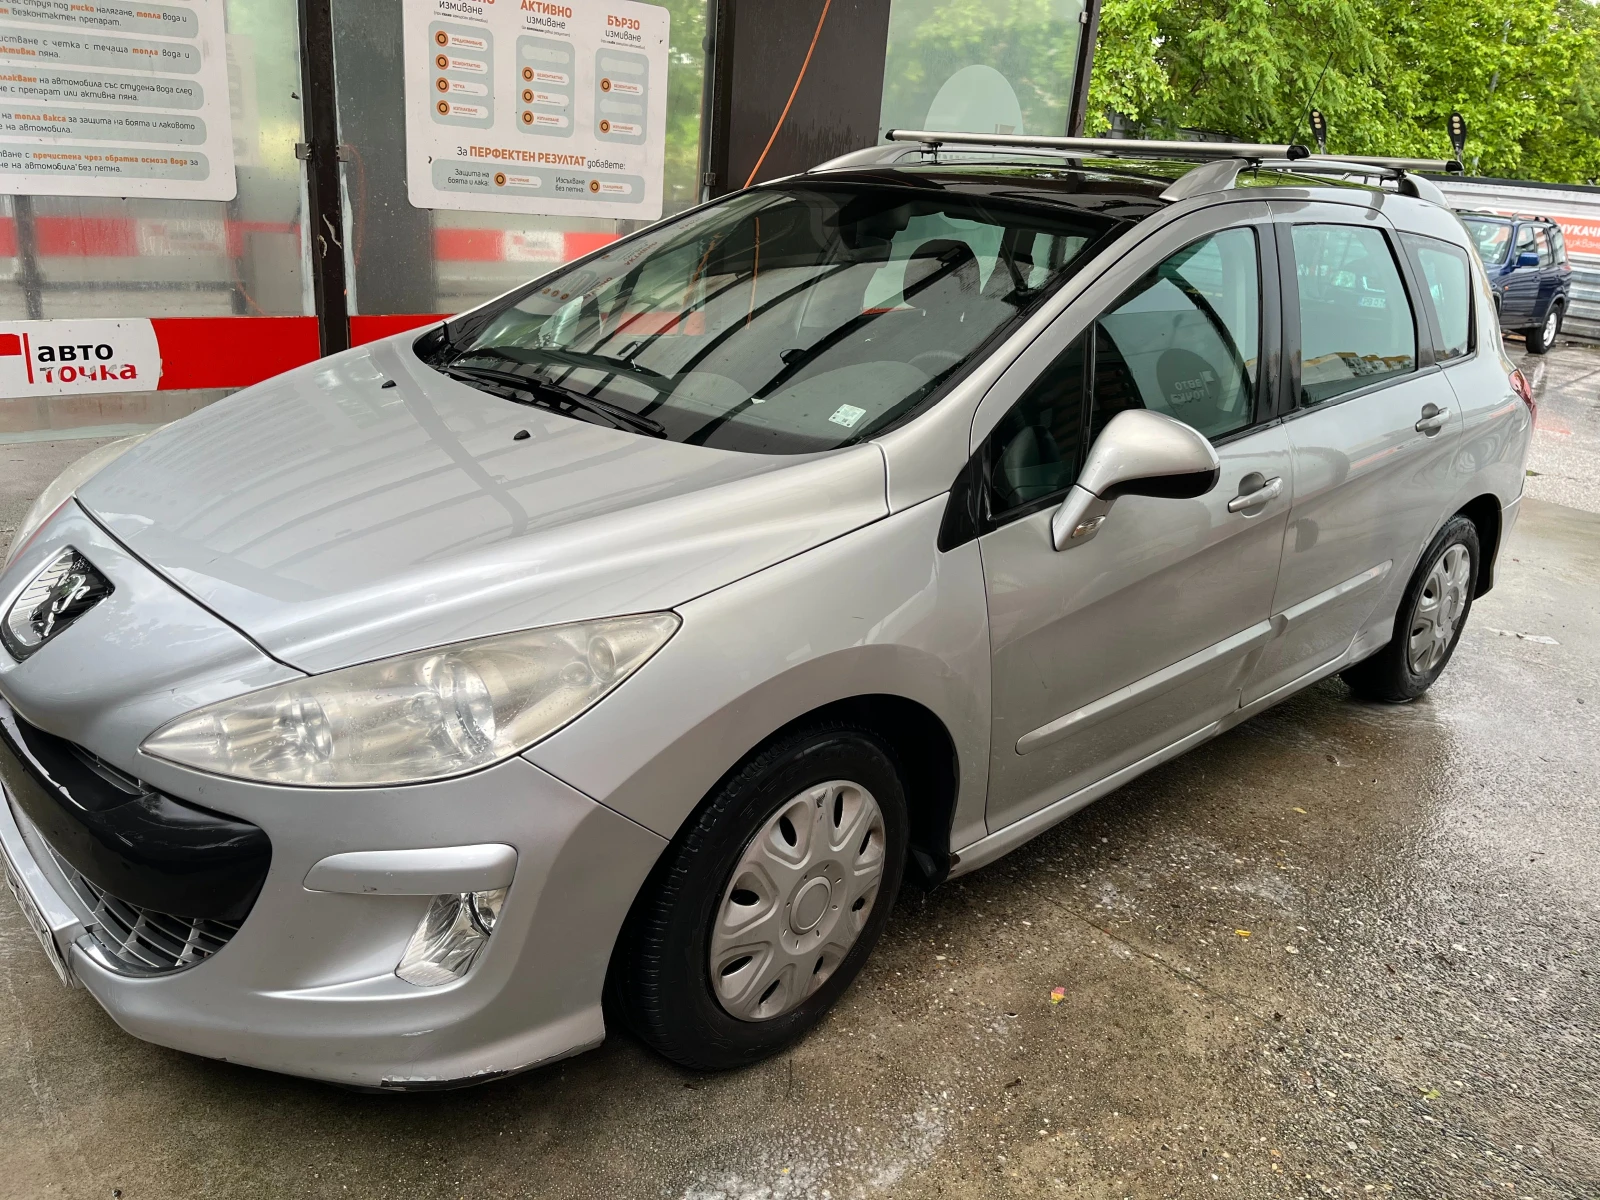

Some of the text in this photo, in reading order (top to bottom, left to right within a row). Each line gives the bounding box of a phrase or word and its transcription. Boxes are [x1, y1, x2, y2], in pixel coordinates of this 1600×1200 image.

[24, 0, 52, 9] струя
[54, 3, 69, 11] под
[71, 4, 95, 12] ниско
[97, 7, 134, 18] налягане,
[137, 11, 161, 19] топла
[163, 13, 181, 22] вода
[439, 1, 483, 15] измиване
[520, 0, 573, 18] АКТИВНО
[12, 8, 77, 22] безконтактен
[80, 16, 122, 26] препарат.
[526, 16, 566, 29] измиване
[607, 15, 640, 30] БЪРЗО
[605, 30, 642, 42] измиване
[39, 50, 61, 58] пяна.
[52, 41, 80, 49] четка
[94, 45, 129, 54] течаща
[132, 48, 158, 56] топла
[162, 49, 181, 59] вода
[19, 87, 60, 96] препарат
[81, 90, 116, 100] активна
[52, 77, 103, 88] автомобила
[120, 83, 155, 92] студена
[156, 85, 174, 94] вода
[175, 87, 193, 96] след
[19, 123, 72, 133] автомобила.
[43, 114, 67, 122] вакса
[80, 117, 112, 125] защита
[114, 118, 124, 126] на
[125, 118, 150, 128] боята
[159, 121, 195, 130] лаковото
[33, 152, 82, 160] пречистена
[84, 154, 102, 162] чрез
[105, 155, 138, 163] обратна
[170, 158, 187, 166] вода
[457, 146, 626, 170] За ПЕРФЕКТЕН РЕЗУЛТАТ добавете:
[25, 162, 75, 171] автомобила
[455, 168, 481, 178] Защита
[447, 176, 469, 185] боята
[474, 179, 490, 187] лака:
[555, 176, 586, 186] Изсъхване
[38, 344, 114, 362] авто
[40, 364, 138, 383] точка
